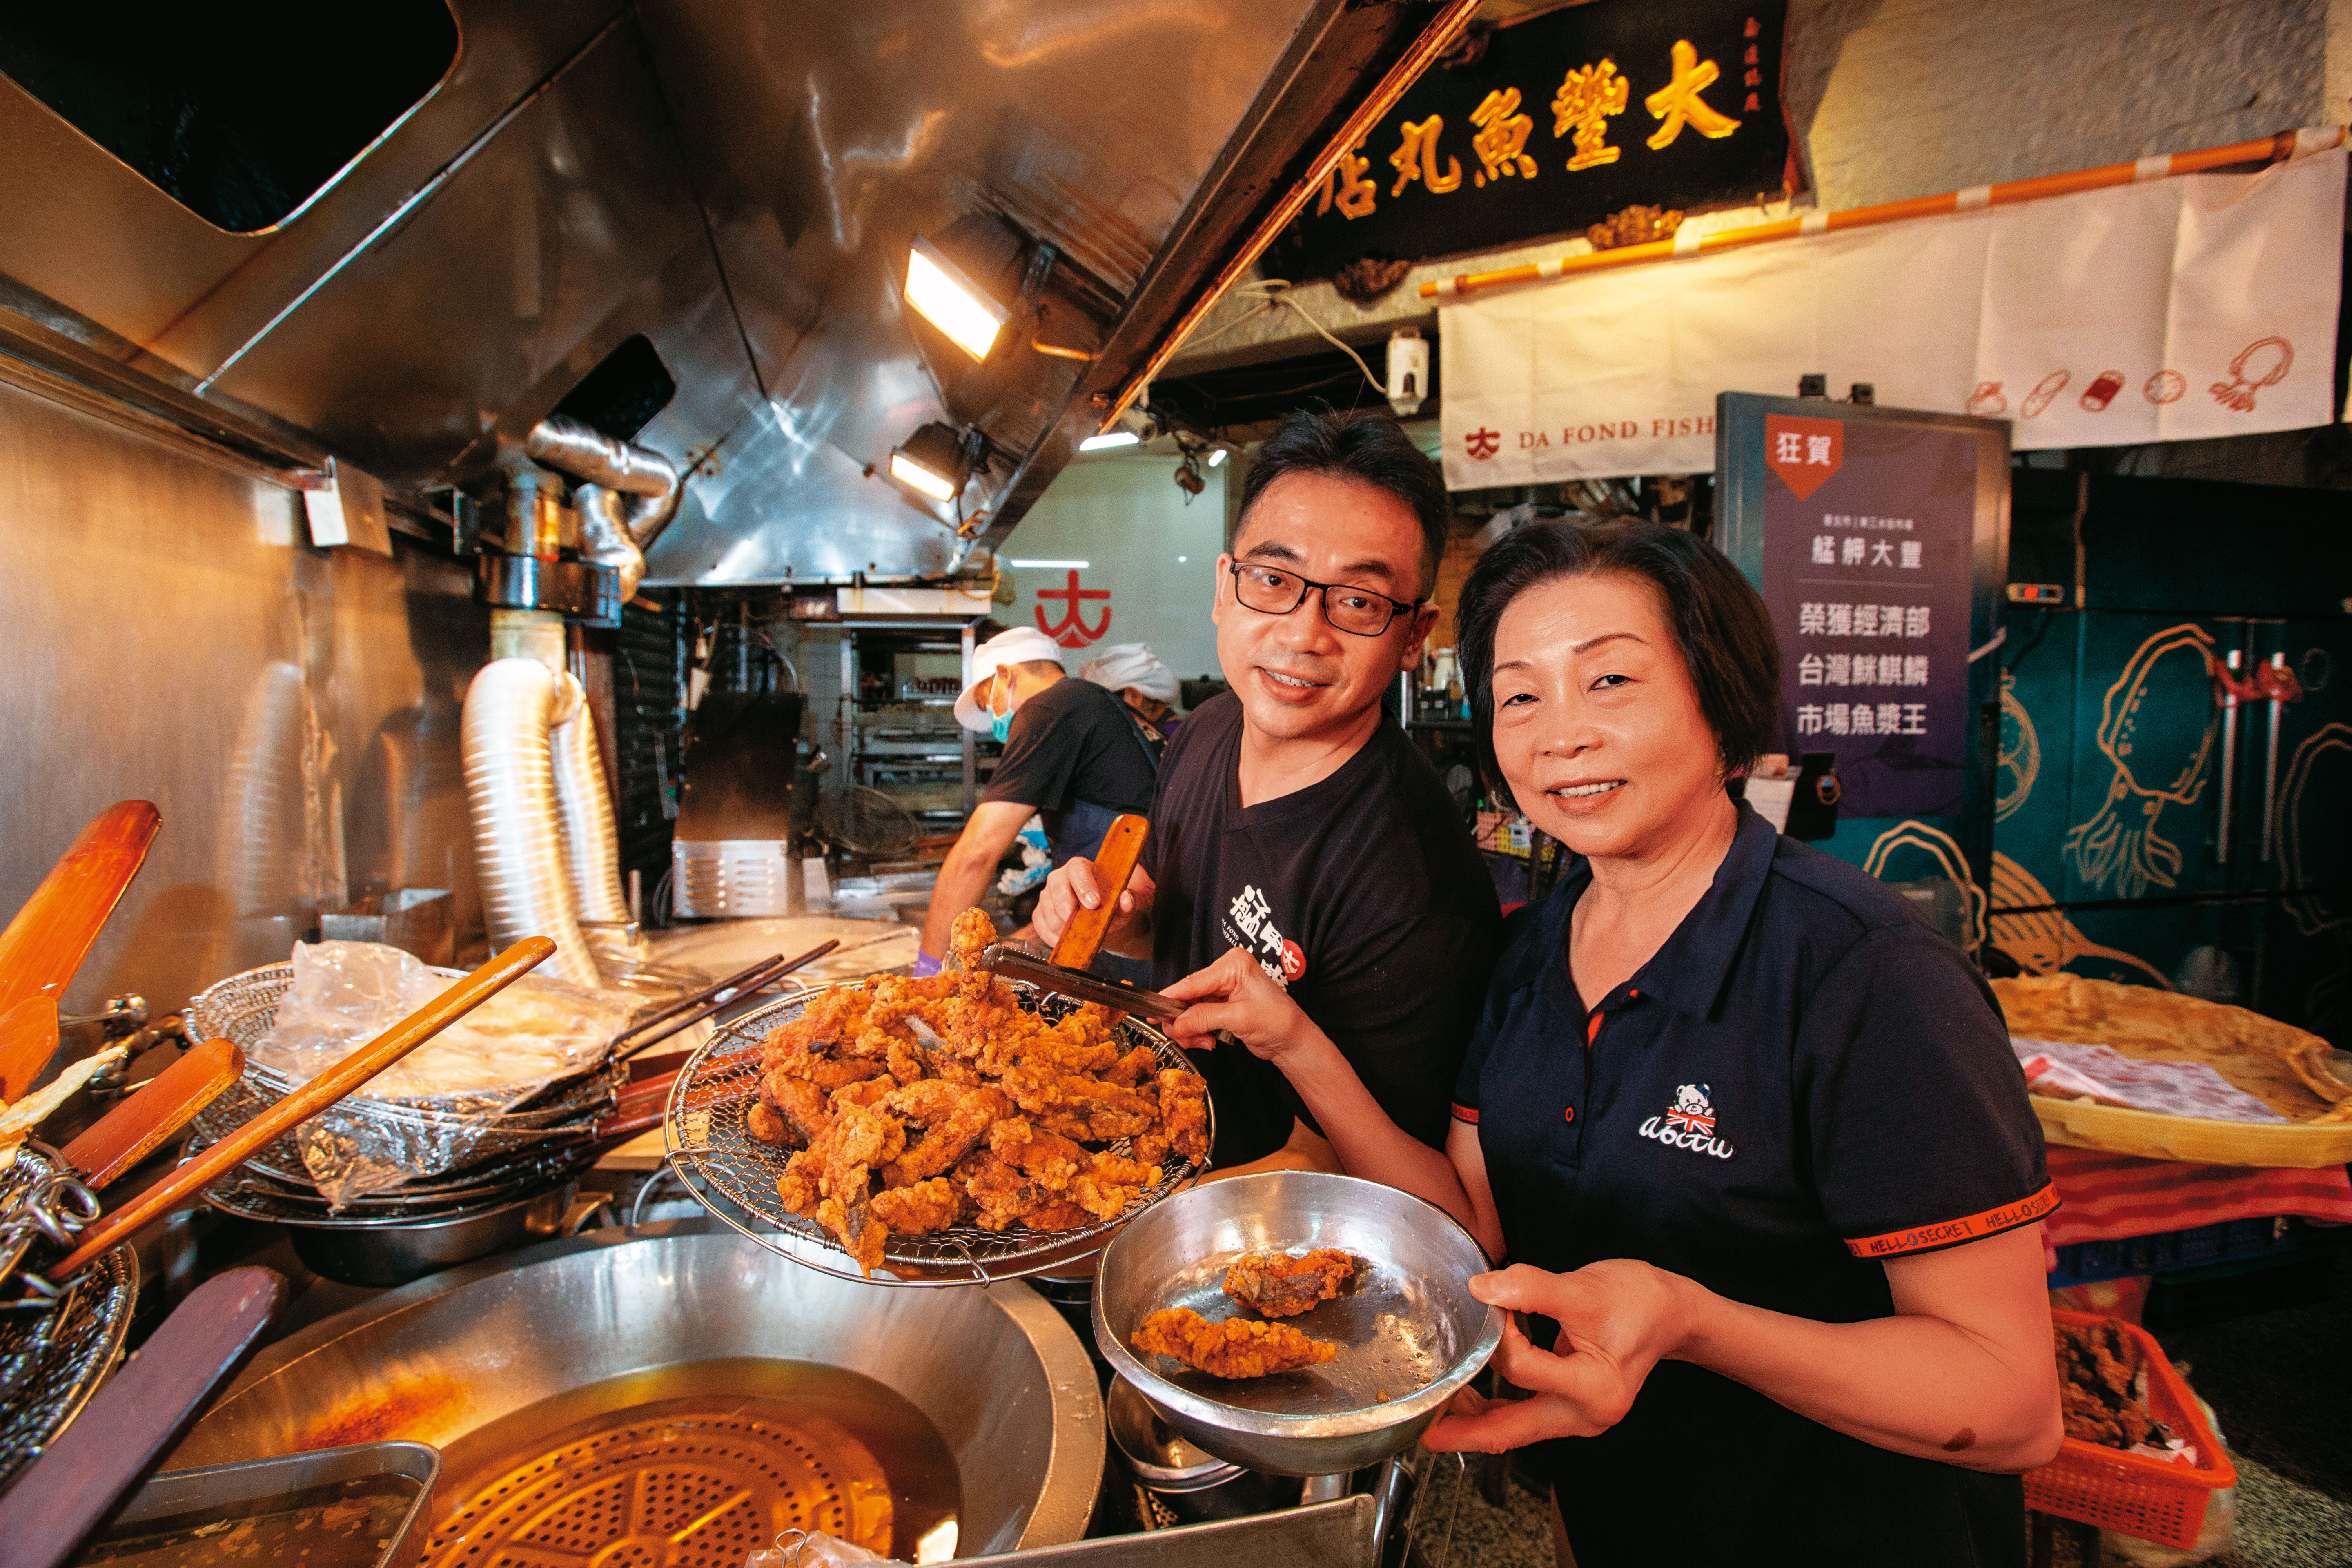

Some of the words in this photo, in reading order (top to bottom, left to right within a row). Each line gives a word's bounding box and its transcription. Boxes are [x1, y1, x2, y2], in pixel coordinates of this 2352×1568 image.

[1519, 431, 1550, 449] DA
[1563, 421, 1638, 445] FOND
[1652, 416, 1714, 438] FISH
[1777, 432, 1832, 465] 狂賀
[1811, 535, 1922, 569] 艋舺大豐
[1799, 601, 1930, 638] 榮獲經濟部
[1797, 702, 1927, 736] 市場魚漿王
[1226, 925, 1239, 940] FOND
